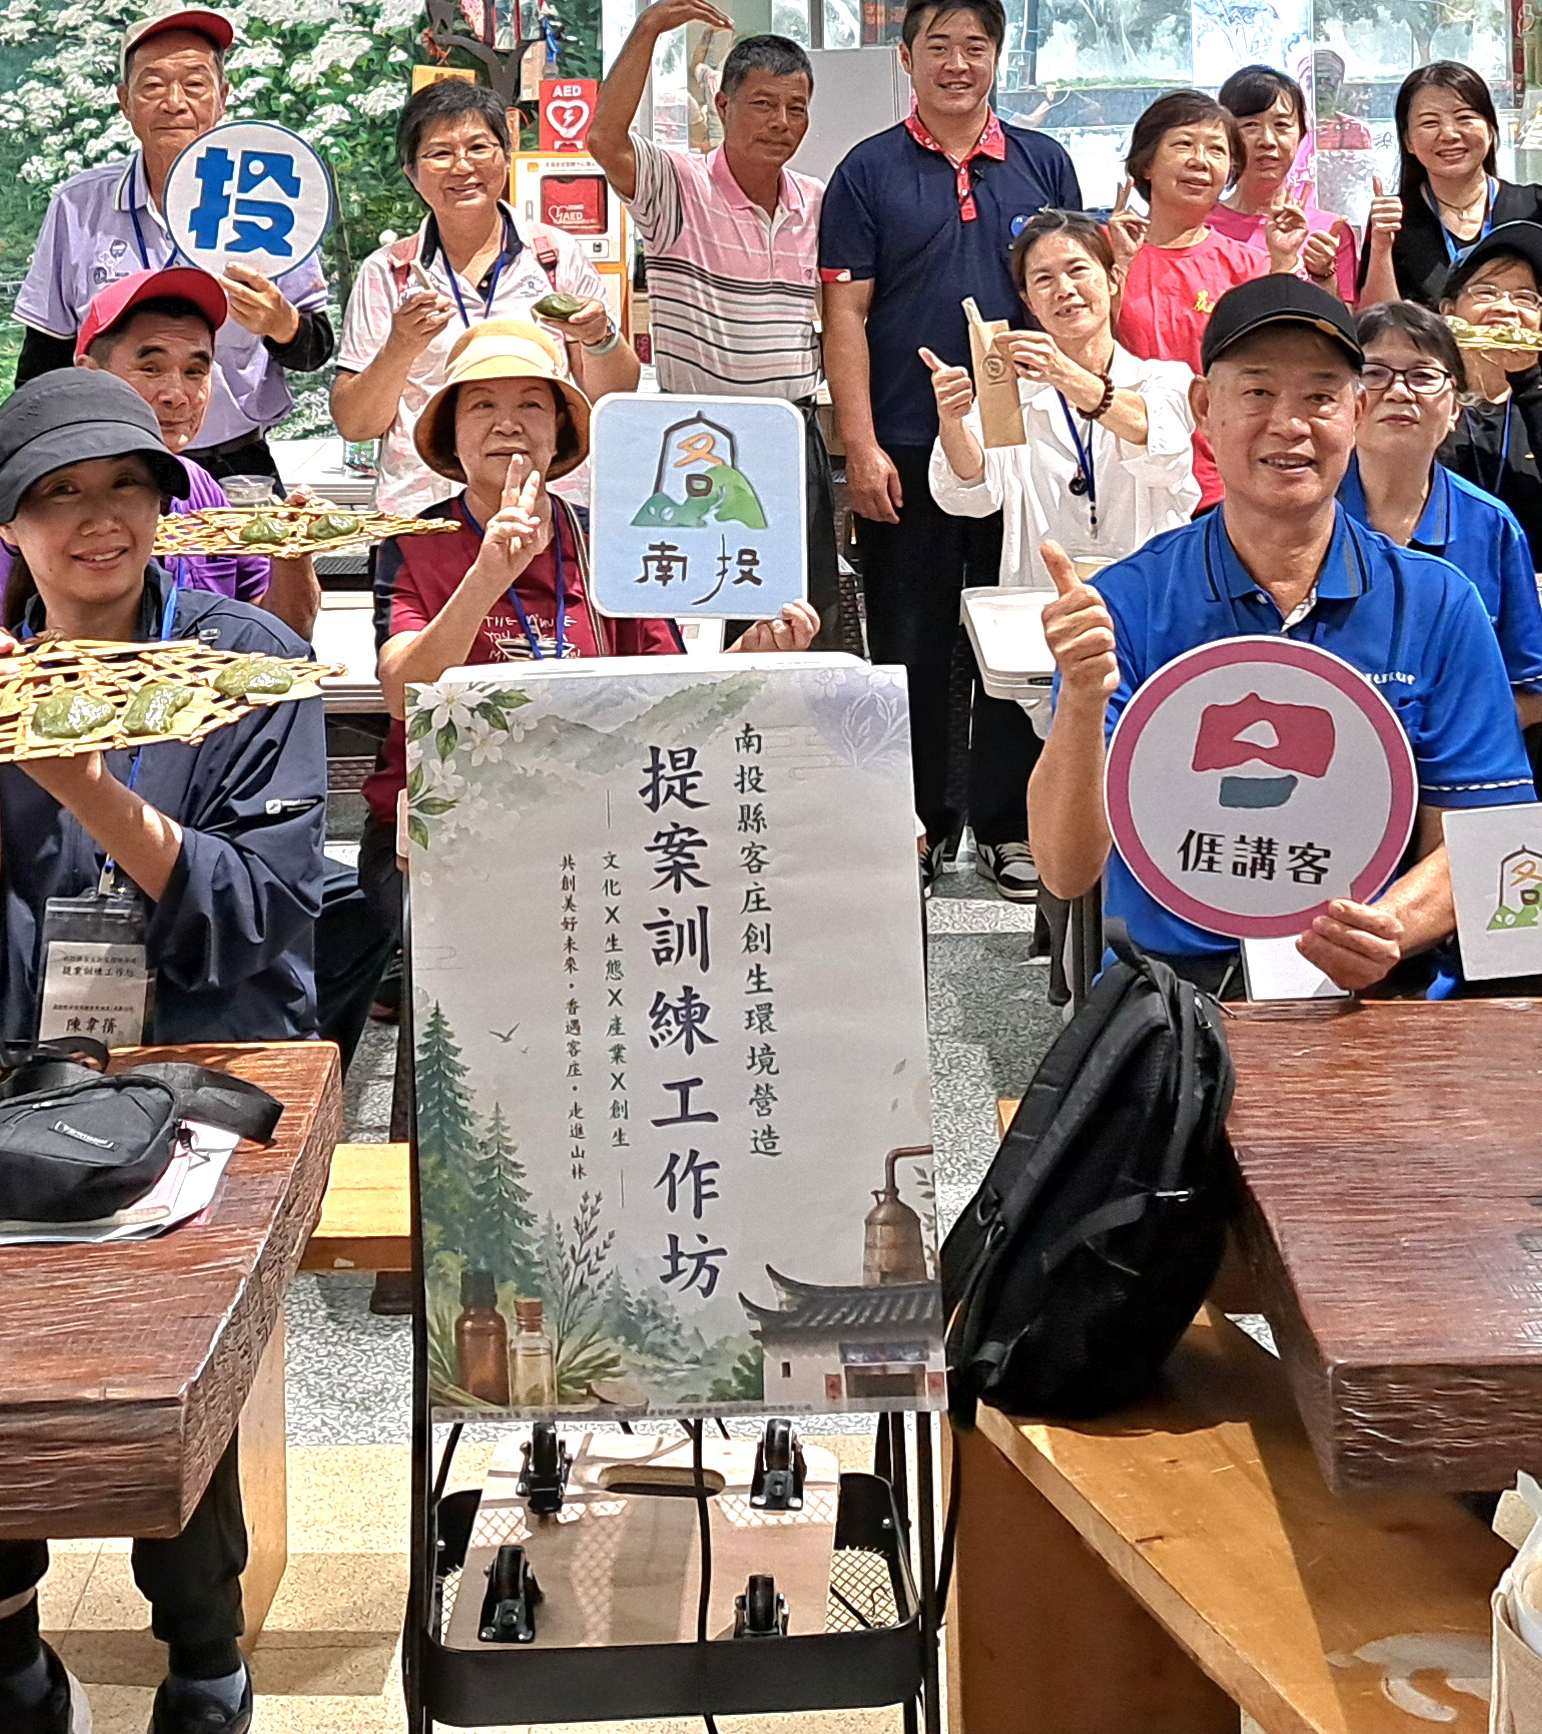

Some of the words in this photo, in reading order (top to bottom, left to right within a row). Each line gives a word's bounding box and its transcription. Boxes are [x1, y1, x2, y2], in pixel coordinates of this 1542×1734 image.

[553, 85, 582, 97] AED
[190, 146, 302, 256] 投
[634, 533, 763, 606] 南投
[484, 616, 518, 628] THE
[734, 722, 783, 1158] 南投縣客庄創生環境營造
[637, 746, 727, 1300] 提案訓練工作坊
